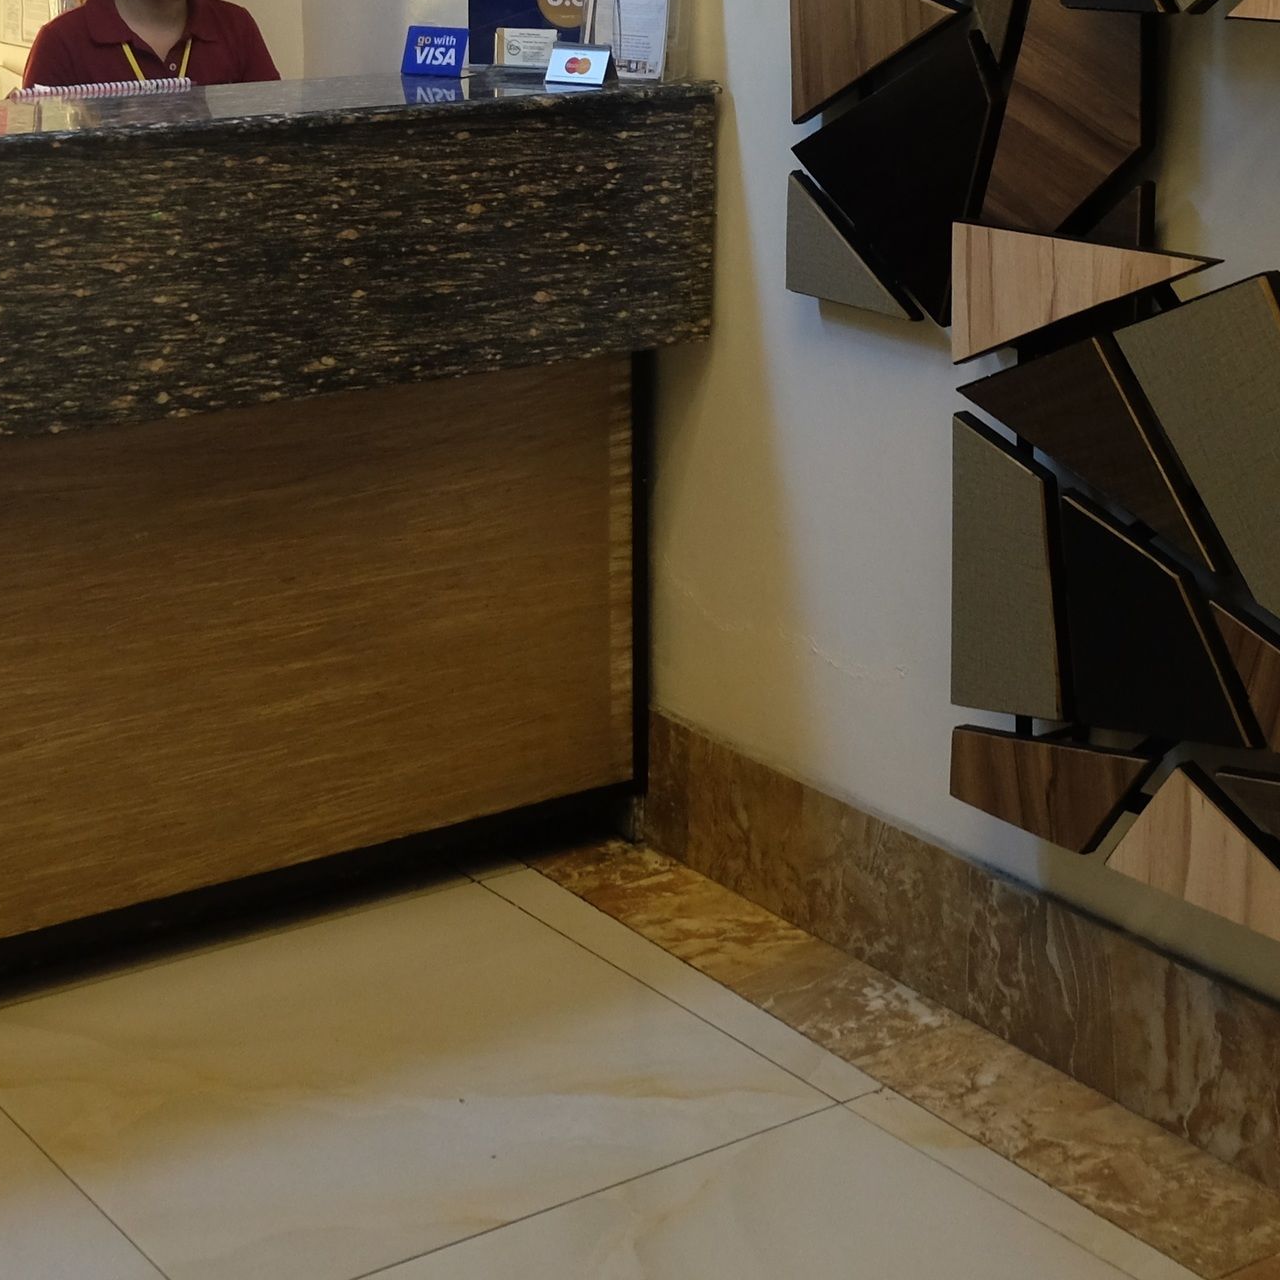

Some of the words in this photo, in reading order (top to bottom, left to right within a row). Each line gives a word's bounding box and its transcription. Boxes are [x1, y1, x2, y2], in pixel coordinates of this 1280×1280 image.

[417, 35, 432, 47] go
[433, 34, 456, 46] with
[415, 47, 456, 66] VISA
